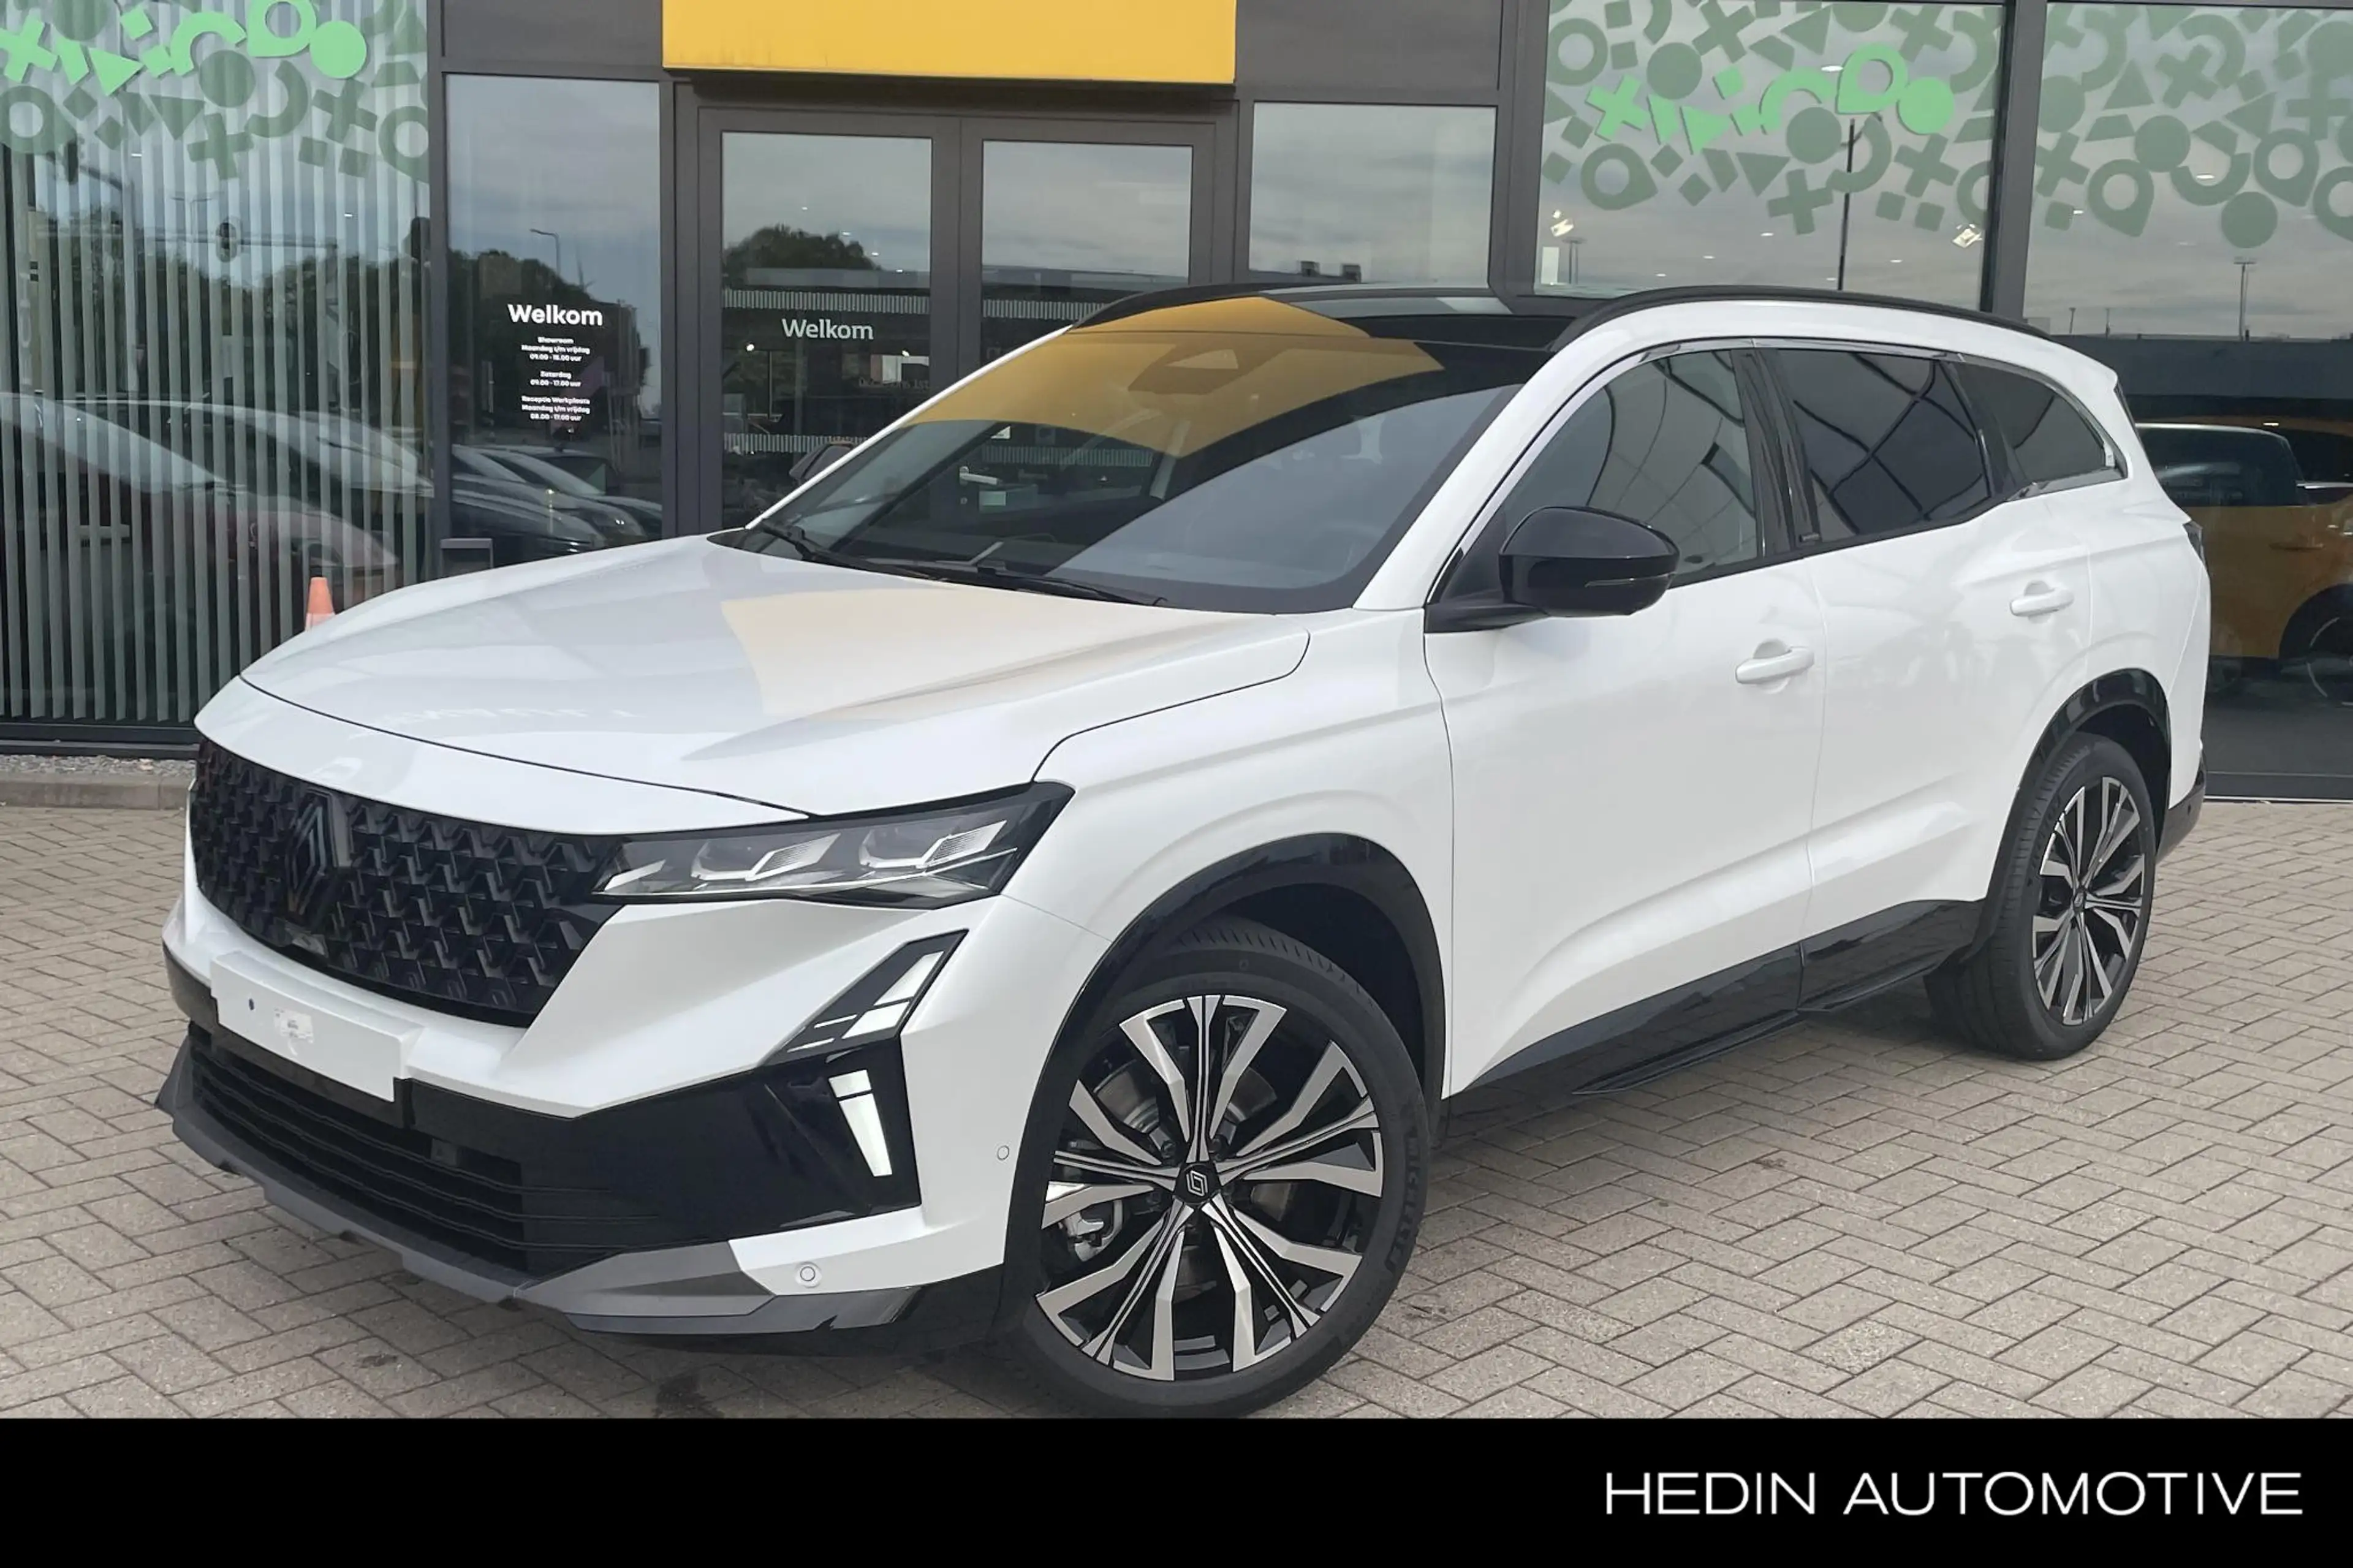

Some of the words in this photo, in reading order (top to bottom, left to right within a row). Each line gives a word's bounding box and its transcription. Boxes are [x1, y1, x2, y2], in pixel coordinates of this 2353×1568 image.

[507, 304, 603, 326] Welkom
[781, 318, 874, 340] Welkom
[540, 371, 572, 380] Zaterdag
[521, 395, 551, 404] Receptie
